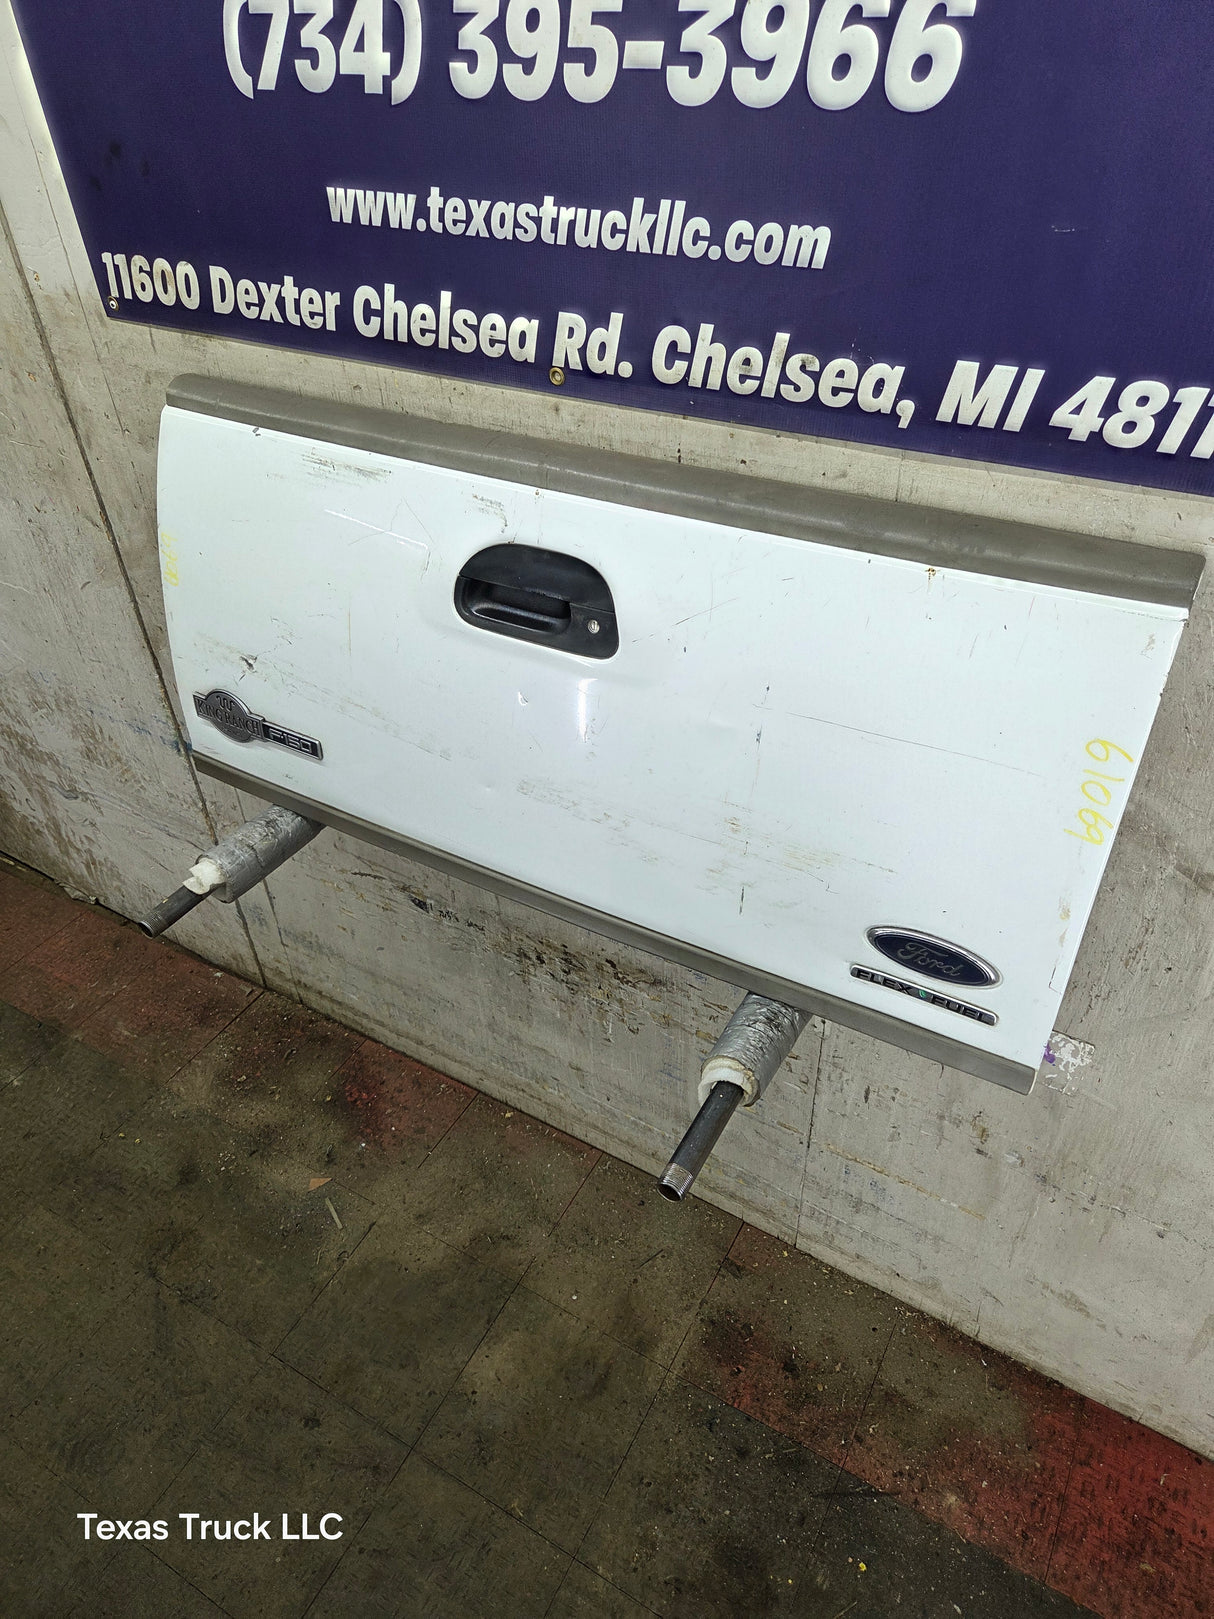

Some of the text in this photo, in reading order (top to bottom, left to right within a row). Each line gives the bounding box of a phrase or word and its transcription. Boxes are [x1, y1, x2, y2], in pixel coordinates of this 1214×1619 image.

[222, 0, 976, 112] (734) 395-3966
[326, 186, 832, 269] www.texastruckllc.com
[101, 252, 199, 310] 11600
[209, 265, 340, 331] Dexter
[353, 283, 539, 363] Chelsea
[552, 311, 634, 379] Rd.
[651, 323, 916, 429] Chelsea,
[935, 360, 1045, 432] MI
[854, 968, 995, 1026] FLEX FUEL
[898, 942, 965, 977] Ford
